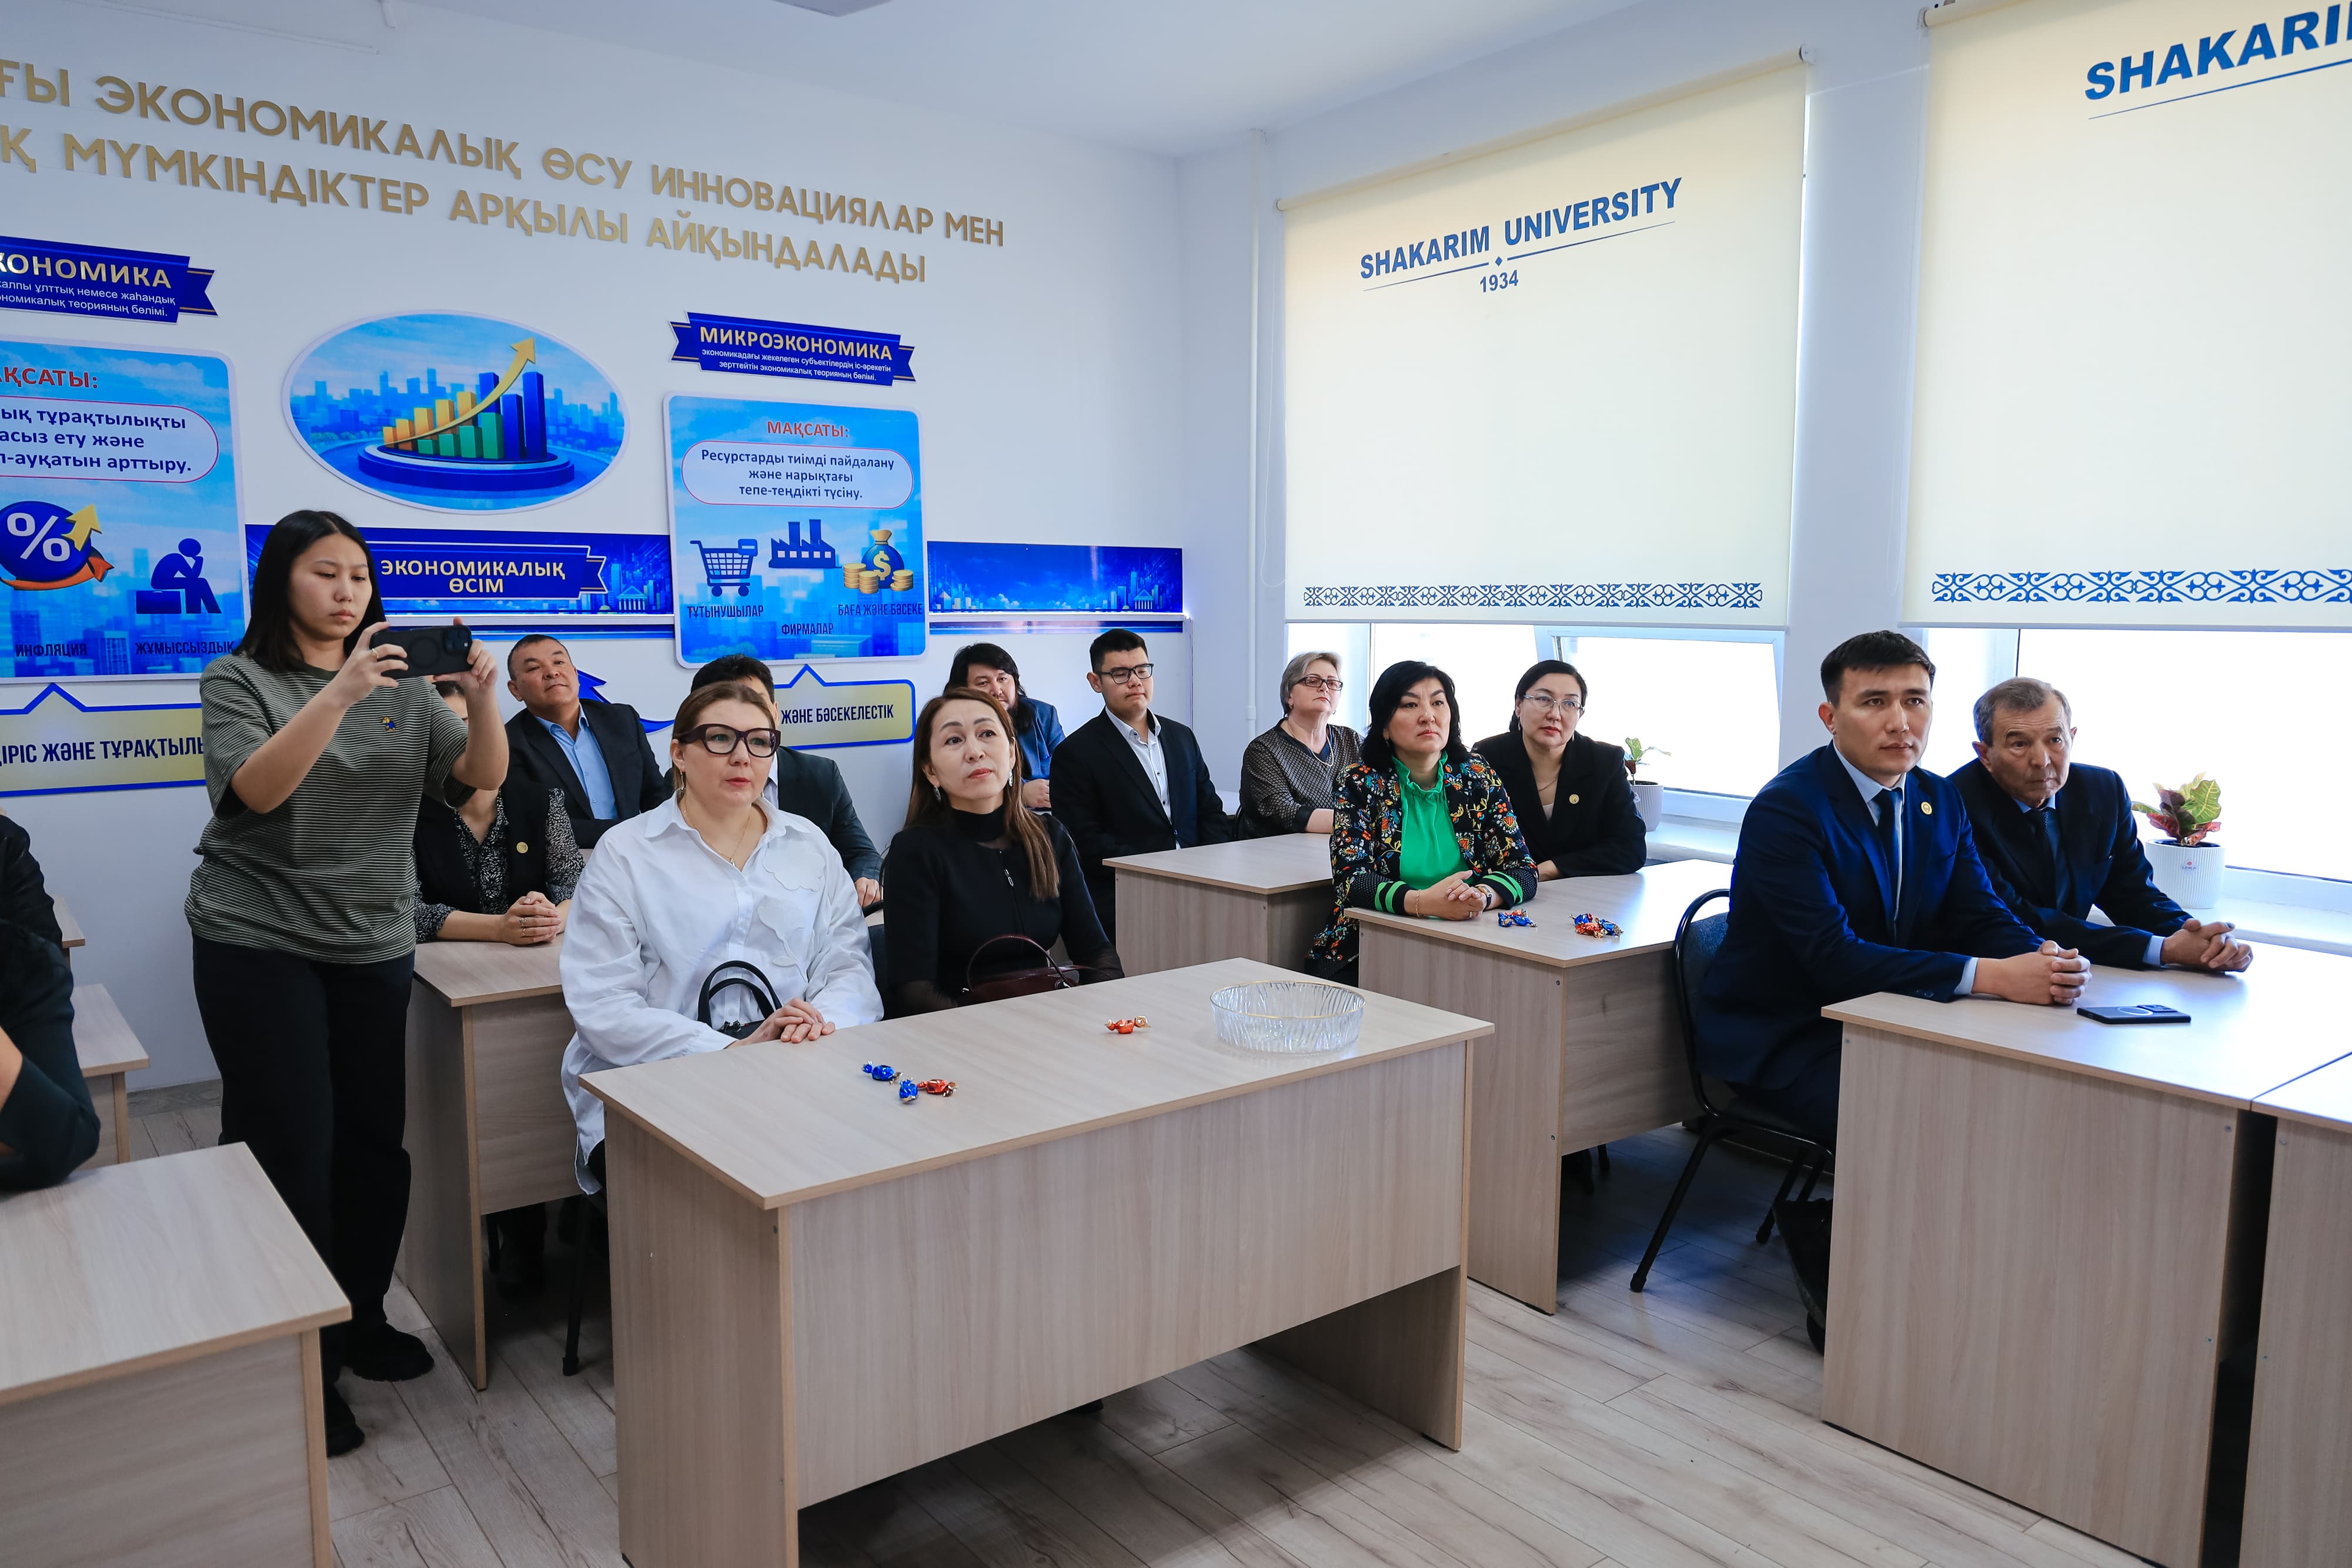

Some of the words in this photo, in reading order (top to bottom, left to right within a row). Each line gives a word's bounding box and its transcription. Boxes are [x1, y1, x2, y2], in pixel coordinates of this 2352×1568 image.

[2084, 1, 2352, 100] SHAKARI
[95, 75, 521, 180] ЭКОНОМИКАЛЫҚ
[542, 147, 633, 189] ӨСУ
[652, 164, 934, 234] ИННОВАЦИЯЛАР
[945, 212, 1004, 247] МЕН
[64, 133, 429, 215] МҮМКІНДІКТЕР
[449, 189, 628, 244] АРҚЫЛЫ
[647, 209, 926, 283] АЙҚЫНДАЛАДЫ
[1360, 225, 1489, 279] SHAKARIM
[1504, 177, 1682, 246] UNIVERSITY
[1479, 270, 1519, 293] 1934
[0, 280, 32, 291] алпы
[35, 284, 75, 296] ұлттық
[77, 288, 118, 299] немесе
[121, 292, 175, 305] жаһандық
[0, 294, 66, 308] номикалық
[68, 300, 129, 315] теорияның
[132, 305, 168, 316] бөлімі.
[700, 326, 893, 361] МИКРОЭКОНОМИКА
[701, 349, 760, 361] экономикадағы
[761, 355, 800, 364] жекелеген
[801, 357, 854, 369] субъектілердің
[855, 361, 891, 372] іс-әрекетін
[0, 366, 98, 389] ҚСАТЫ:
[719, 361, 759, 371] зерттейтін
[760, 364, 813, 376] экономикалық
[813, 369, 852, 379] теорияның
[853, 371, 876, 381] бөлімі.
[36, 410, 186, 430] тұрақтылықты
[767, 420, 850, 438] МАҚСАТЫ:
[0, 430, 48, 444] асыз
[54, 433, 86, 448] ету
[92, 435, 145, 448] және
[107, 458, 192, 474] арттыру.
[701, 449, 784, 463] Ресурстарды
[787, 453, 827, 466] тиімді
[830, 455, 894, 470] пайдалану
[749, 470, 782, 479] және
[786, 472, 853, 483] нарықтағы
[739, 486, 821, 498] тепе-теңдікті
[824, 487, 863, 500] түсіну.
[380, 560, 566, 580] ЭКОНОМИКАЛЫҚ
[449, 578, 504, 593] ӨСІМ
[687, 606, 764, 618] ТҰТЫНУШЫЛАР
[838, 604, 861, 616] БАҒА
[863, 603, 888, 616] ЖӘНЕ
[891, 603, 923, 616] БӘСЕКЕ
[781, 622, 834, 635] ФИРМАЛАР
[15, 643, 88, 657] ИНФЛЯЦИЯ
[781, 709, 813, 724] ЖӘНЕ
[816, 704, 894, 723] БӘСЕКЕЛЕСТІК
[0, 744, 37, 765] ІРІС
[42, 741, 96, 763] ЖӘНЕ
